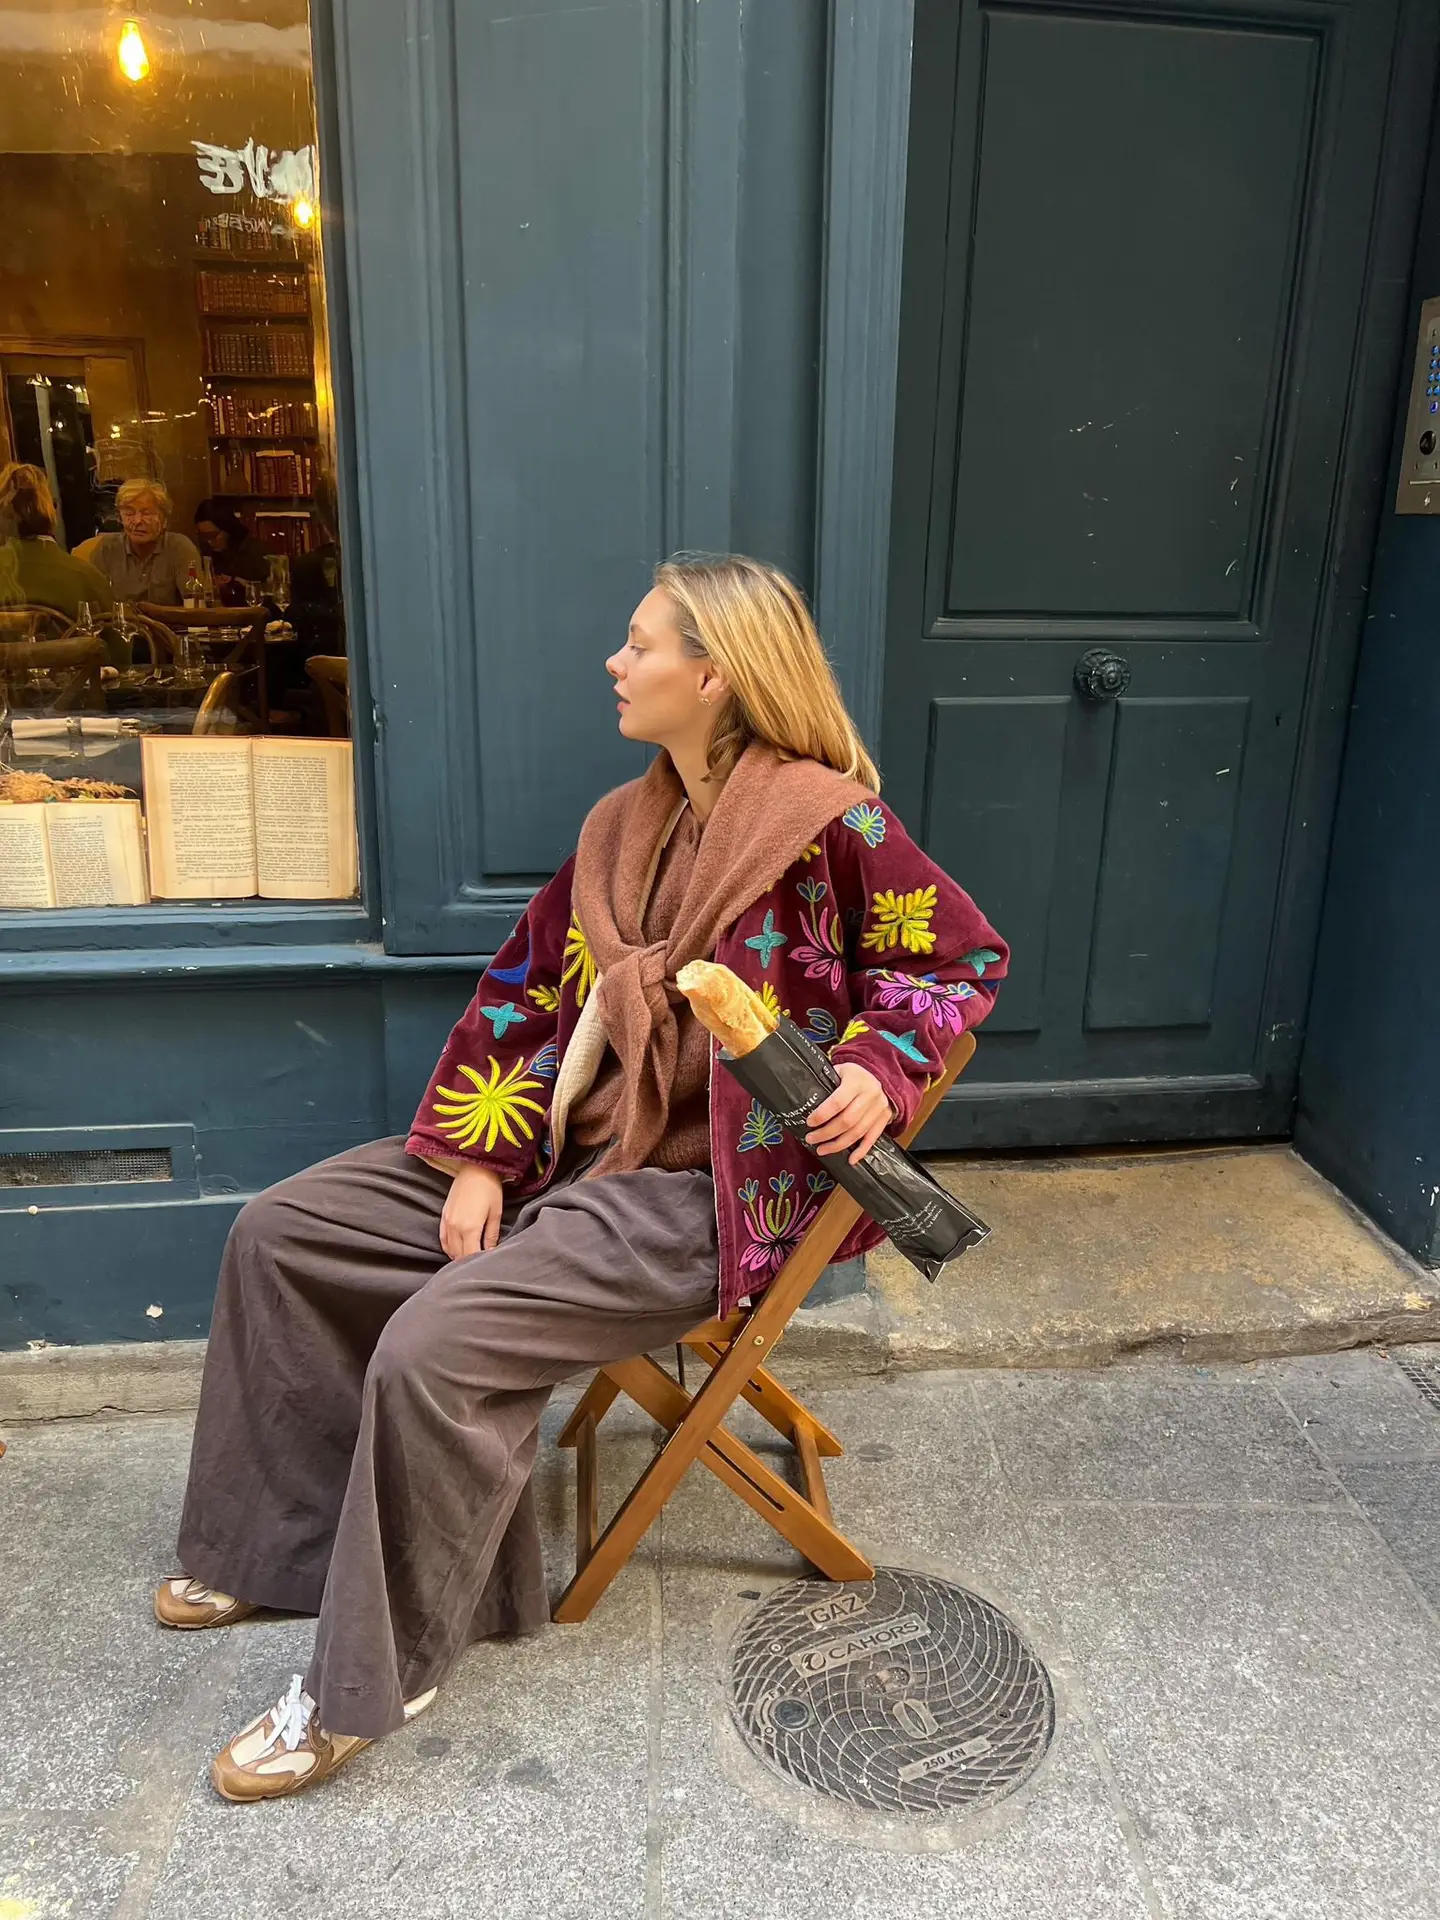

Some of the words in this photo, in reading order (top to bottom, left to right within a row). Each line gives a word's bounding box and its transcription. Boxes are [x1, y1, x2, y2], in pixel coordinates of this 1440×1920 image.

[810, 1596, 864, 1623] GAZ
[828, 1621, 920, 1659] CAHORS
[922, 1755, 946, 1771] 250
[947, 1747, 967, 1761] KN
